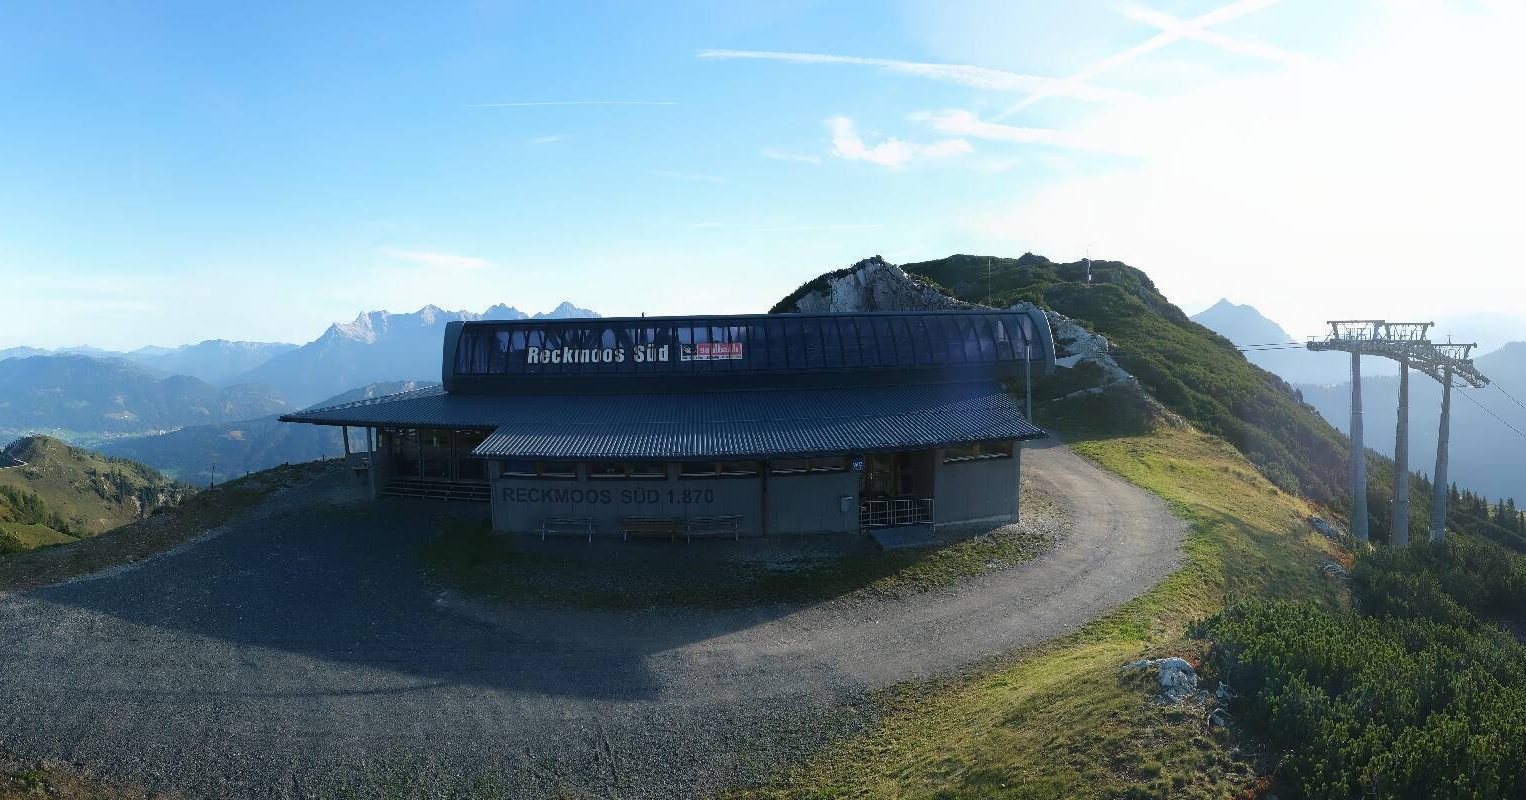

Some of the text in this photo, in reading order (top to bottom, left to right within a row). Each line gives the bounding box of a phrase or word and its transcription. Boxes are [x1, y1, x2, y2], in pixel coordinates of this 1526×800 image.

[527, 344, 670, 364] Reckmoos Süd
[502, 486, 715, 504] RECKMOOS SÜD 1.870
